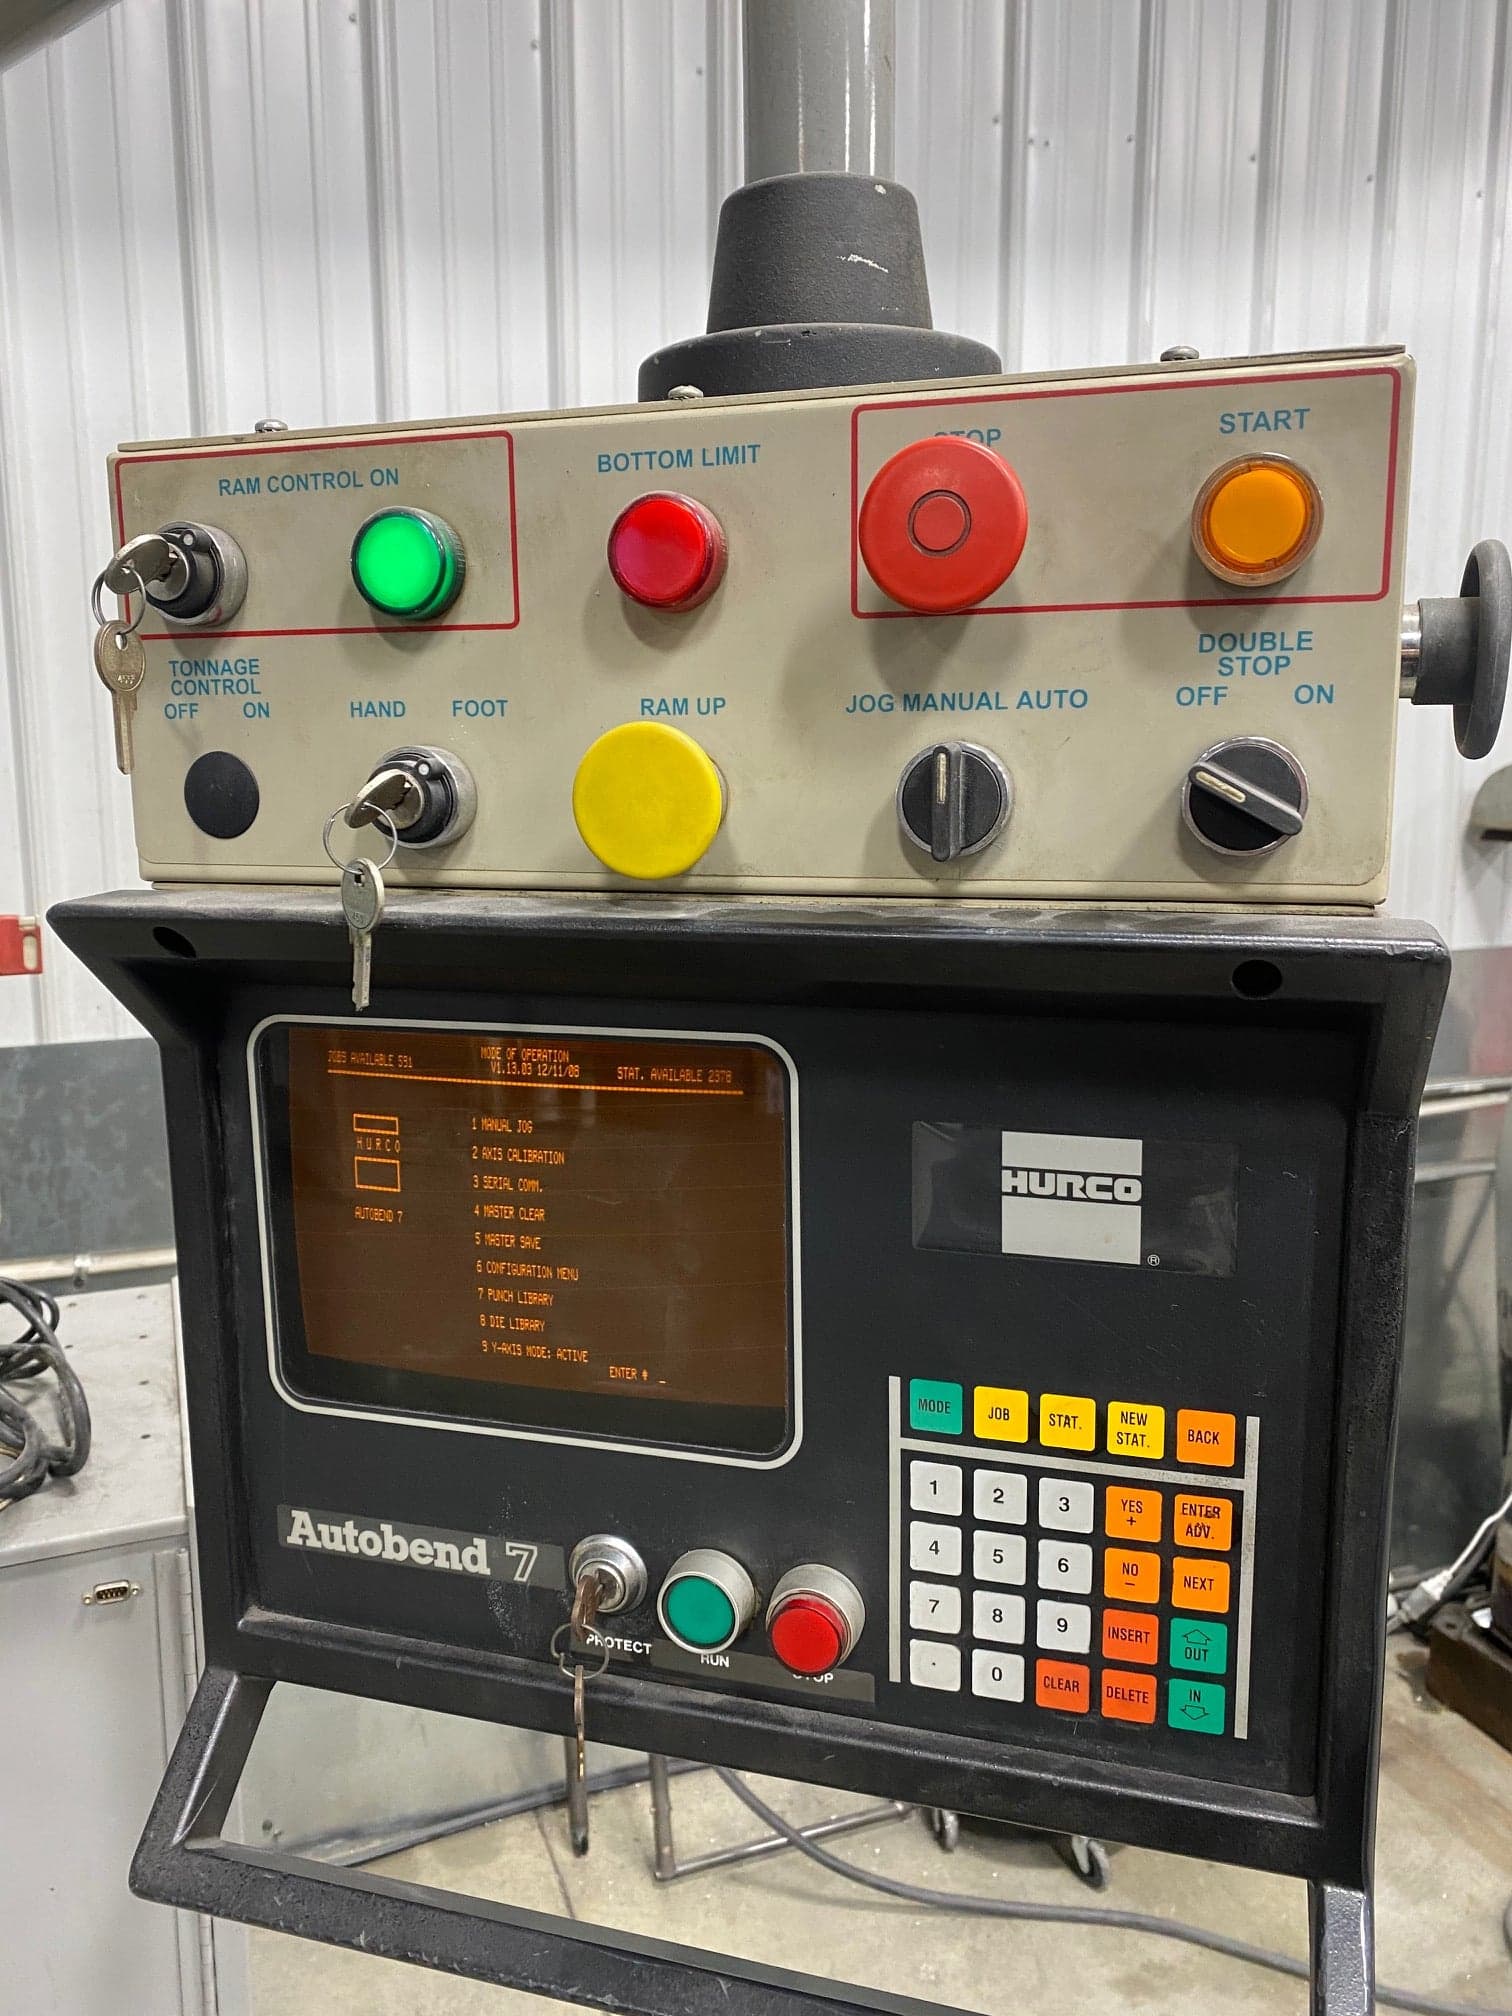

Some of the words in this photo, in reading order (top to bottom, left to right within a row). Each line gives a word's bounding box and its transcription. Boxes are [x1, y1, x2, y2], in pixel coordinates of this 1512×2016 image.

[1219, 408, 1310, 433] START
[934, 428, 1002, 447] OP
[597, 448, 695, 474] BOTTOM
[700, 444, 761, 468] LIMIT
[219, 476, 262, 497] RAM
[266, 470, 364, 494] CONTROL
[370, 468, 399, 488] ON
[1199, 630, 1313, 654] DOUBLE
[168, 658, 260, 678] TONNAGE
[1217, 654, 1291, 677] STOP
[170, 676, 262, 695] CONTROL
[1294, 683, 1335, 705] ON
[846, 693, 894, 713] JOG
[902, 690, 1008, 712] MANUAL
[1016, 688, 1089, 710] AUTO
[1176, 685, 1228, 707] OFF
[163, 702, 199, 719] OFF
[243, 700, 271, 718] ON
[350, 700, 407, 718] HAND
[452, 698, 508, 717] FOOT
[640, 698, 690, 716] RAM
[696, 697, 726, 715] UP
[351, 1051, 396, 1069] AVAILABLE
[481, 1046, 502, 1060] MODE
[506, 1047, 517, 1060] OF
[521, 1048, 570, 1063] OPERATION
[616, 1066, 646, 1082] STAT.
[650, 1067, 704, 1083] AVAILABLE
[471, 1116, 478, 1131] 1
[481, 1116, 513, 1132] MANUAL
[517, 1119, 534, 1134] JOG
[471, 1145, 479, 1160] 2
[482, 1146, 503, 1161] AXIS
[506, 1148, 565, 1165] CALIBRATION
[472, 1174, 479, 1189] 3
[482, 1175, 514, 1190] SERIAL
[518, 1178, 543, 1193] COMM.
[1001, 1169, 1143, 1203] HURCO
[354, 1206, 394, 1222] AUTOBEND
[396, 1210, 404, 1223] 7
[473, 1203, 480, 1217] 4
[483, 1204, 515, 1219] MASTER
[518, 1207, 545, 1221] CLEAR
[474, 1231, 481, 1245] 5
[484, 1233, 516, 1248] MASTER
[519, 1235, 542, 1250] SAVE
[476, 1259, 482, 1273] 6
[485, 1261, 553, 1279] CONFIGURATION
[556, 1266, 579, 1281] MENU
[477, 1287, 484, 1300] 7
[487, 1288, 514, 1303] PUNCH
[517, 1291, 555, 1307] LIBRARY
[479, 1313, 486, 1327] 8
[489, 1315, 506, 1329] DIE
[509, 1318, 546, 1332] LIBRARY
[491, 1341, 523, 1356] Y-AXIS
[526, 1344, 551, 1359] MODE:
[556, 1348, 589, 1363] ACTIVE
[608, 1366, 638, 1380] ENTER
[918, 1398, 951, 1415] MODE
[988, 1406, 1011, 1421] JOB
[1048, 1413, 1083, 1431] STAT.
[1120, 1411, 1148, 1427] NEW
[1116, 1431, 1151, 1449] STAT.
[1187, 1428, 1220, 1445] BACK
[929, 1479, 938, 1496] 1
[992, 1487, 1005, 1504] 2
[1058, 1496, 1070, 1513] 3
[1121, 1498, 1144, 1514] YES
[1180, 1502, 1221, 1520] ENTER
[1185, 1523, 1216, 1540] ADV.
[286, 1508, 492, 1577] Autobend
[504, 1540, 538, 1583] 7
[928, 1539, 940, 1556] 4
[992, 1548, 1004, 1564] 5
[1057, 1557, 1070, 1574] 6
[1122, 1562, 1139, 1577] NO
[1183, 1575, 1215, 1592] NEXT
[928, 1598, 940, 1614] 7
[991, 1608, 1004, 1624] 8
[1056, 1617, 1068, 1633] 9
[1108, 1626, 1150, 1645] INSERT
[700, 1653, 730, 1668] RUN
[1184, 1646, 1209, 1663] OUT
[991, 1666, 1003, 1682] 0
[1043, 1675, 1080, 1694] CLEAR
[1106, 1685, 1149, 1704] DELETE
[1189, 1688, 1201, 1703] IN
